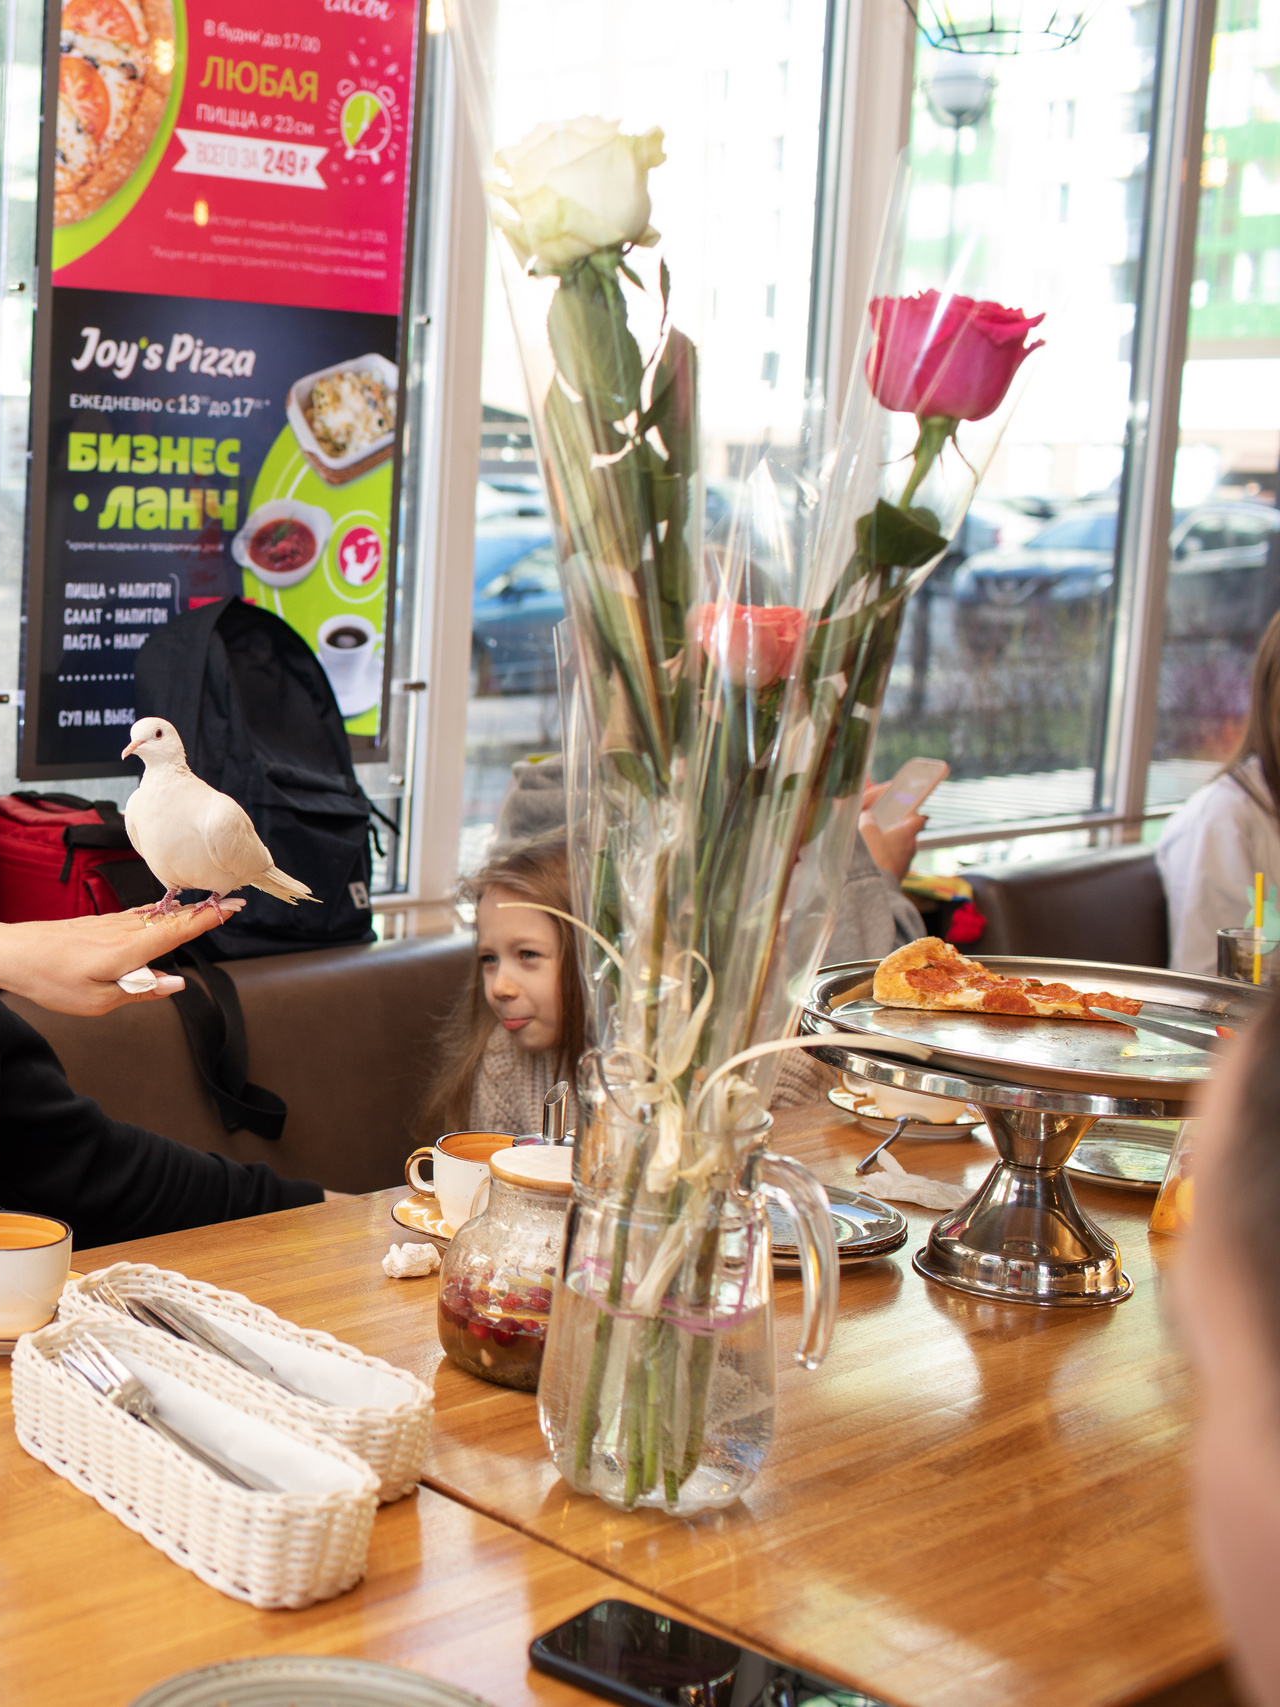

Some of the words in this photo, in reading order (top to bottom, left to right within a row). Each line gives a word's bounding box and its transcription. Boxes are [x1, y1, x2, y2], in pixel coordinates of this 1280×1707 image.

[203, 19, 216, 37] В
[261, 32, 282, 48] до
[283, 32, 321, 54] 17.00
[199, 55, 319, 104] ЛЮБАЯ
[196, 103, 258, 130] ПИЦЦА
[196, 142, 238, 167] ВСЕГО
[240, 147, 259, 169] ЗА
[263, 147, 297, 176] 249
[71, 326, 165, 380] Joy's
[165, 333, 256, 379] Pizza
[70, 393, 163, 413] ЕЖЕДНЕВНО
[165, 398, 176, 414] с
[207, 400, 231, 418] до
[67, 431, 241, 477] БИЗНЕС
[65, 582, 106, 600] ПИЦЦА
[118, 582, 171, 599] НАПИТОК
[64, 608, 102, 625] САЛАТ
[114, 607, 168, 624] НАПИТОК
[63, 633, 102, 651] ПАСТА
[113, 633, 150, 649] НАПИ
[58, 710, 82, 727] СУП
[84, 709, 101, 725] НА
[103, 708, 135, 725] ВЫБО
